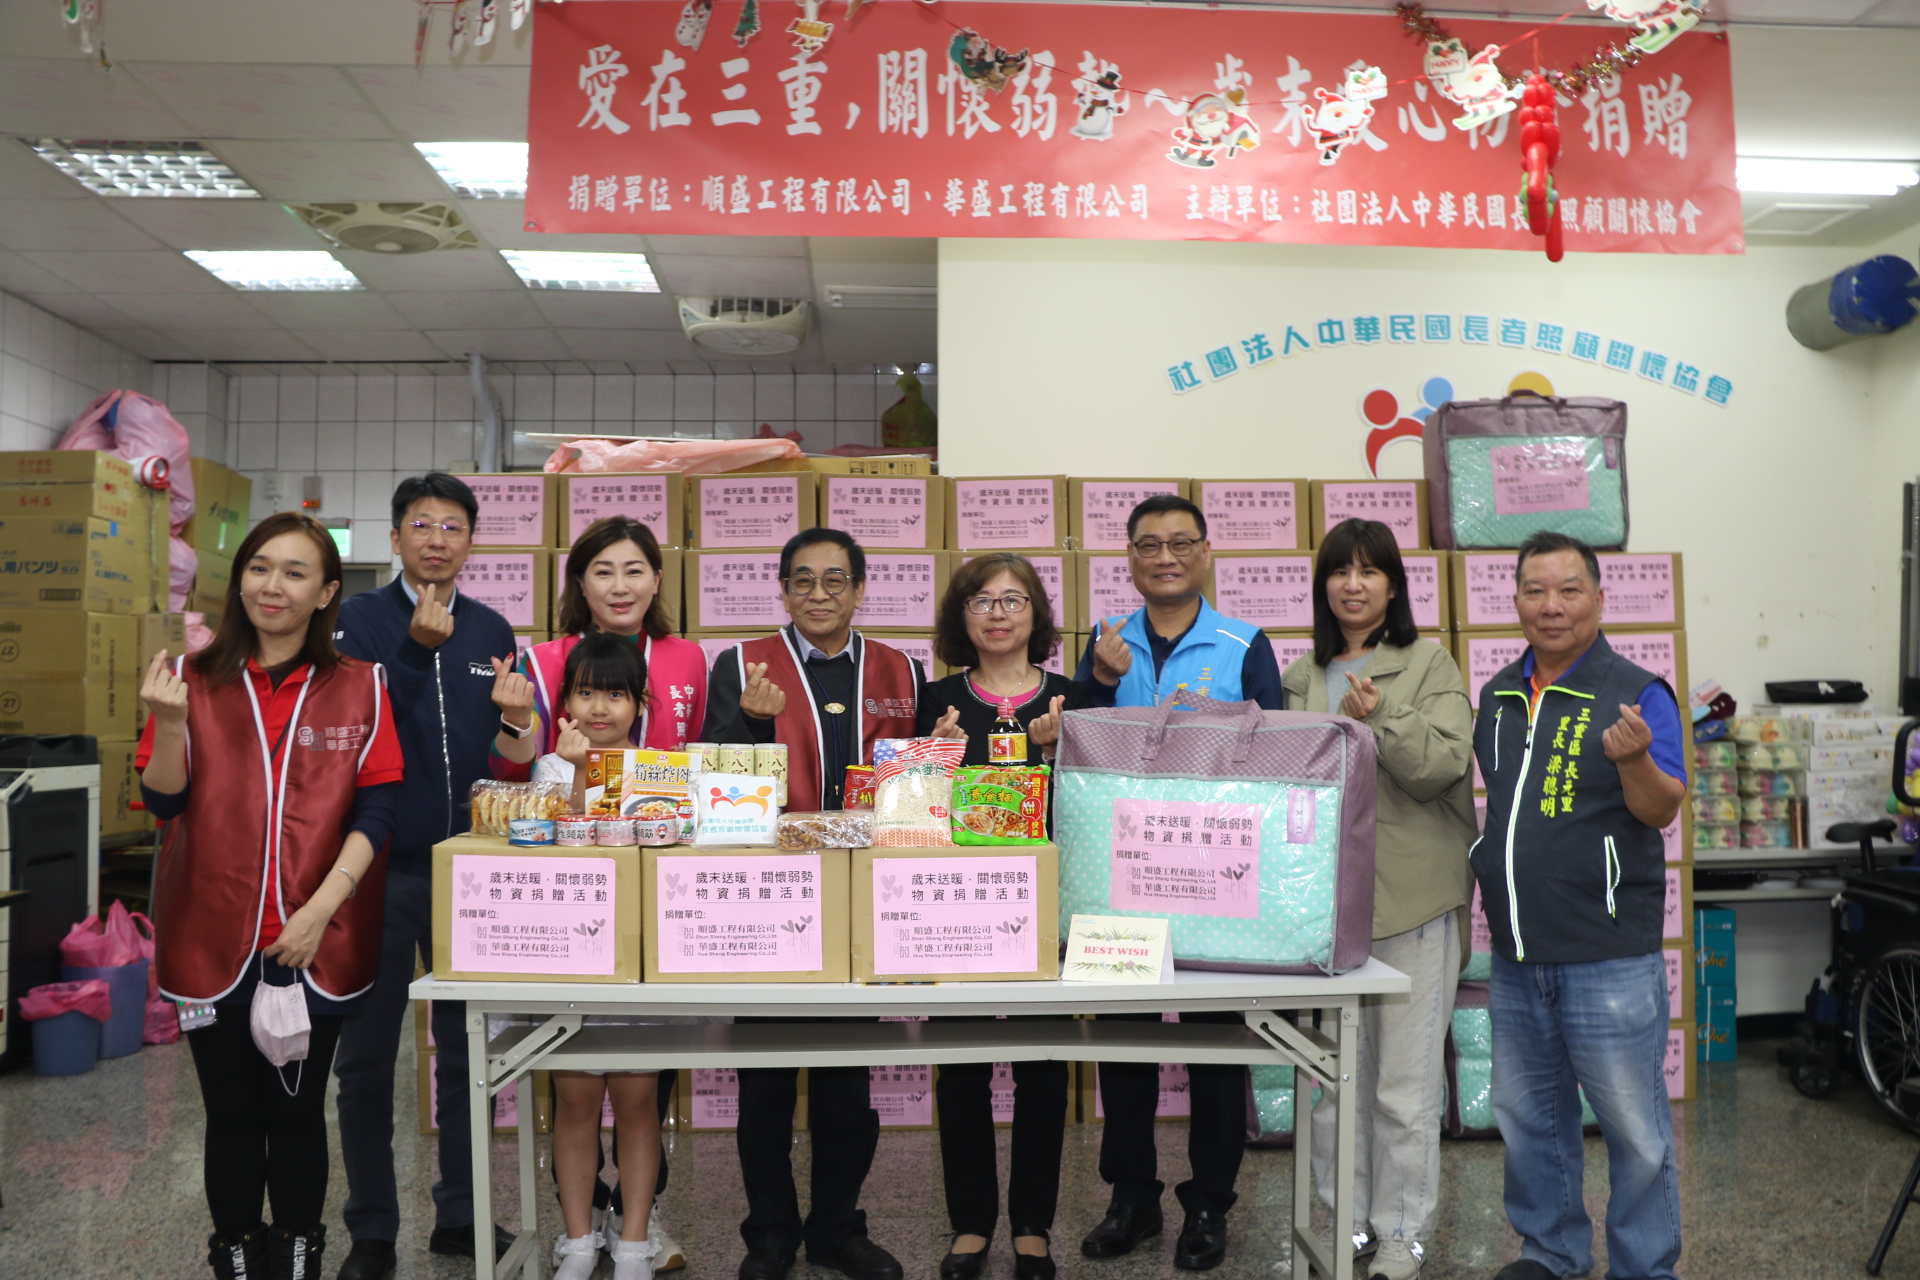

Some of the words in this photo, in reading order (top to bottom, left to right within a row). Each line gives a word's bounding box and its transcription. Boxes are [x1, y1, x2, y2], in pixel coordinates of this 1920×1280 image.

[1184, 184, 1702, 236] 主辦單位：社團法人中華民國長照顧關懷協會
[1169, 314, 1734, 406] 社團法人中華民國長者照顧關懷協會
[1552, 716, 1571, 749] 里長
[1568, 708, 1591, 756] 三重區
[1561, 760, 1580, 813] 長元里
[968, 786, 1013, 803] 素食麵
[1143, 830, 1252, 847] 物資捐贈活動
[1116, 850, 1152, 860] 捐贈單位:
[1144, 866, 1215, 878] 順盛工程有限公司
[489, 888, 608, 902] 物資捐贈活動
[695, 887, 814, 900] 物資捐贈活動
[911, 887, 1029, 901] 物資捐贈活動
[1145, 883, 1216, 895] 華盛工程有限公司
[459, 909, 499, 919] 捐贈單位:
[664, 910, 706, 919] 捐贈單位:
[880, 911, 922, 921] 捐贈單位:
[491, 925, 568, 935] 順盛工程有限公司
[698, 924, 775, 933] 順盛工程有限公司
[913, 925, 991, 935] 順盛工程有限公司
[492, 942, 569, 953] 華盛工程有限公司
[699, 942, 777, 951] 華盛工程有限公司
[915, 943, 992, 952] 華盛工程有限公司
[1084, 946, 1114, 954] BEST
[1117, 948, 1149, 956] WISH
